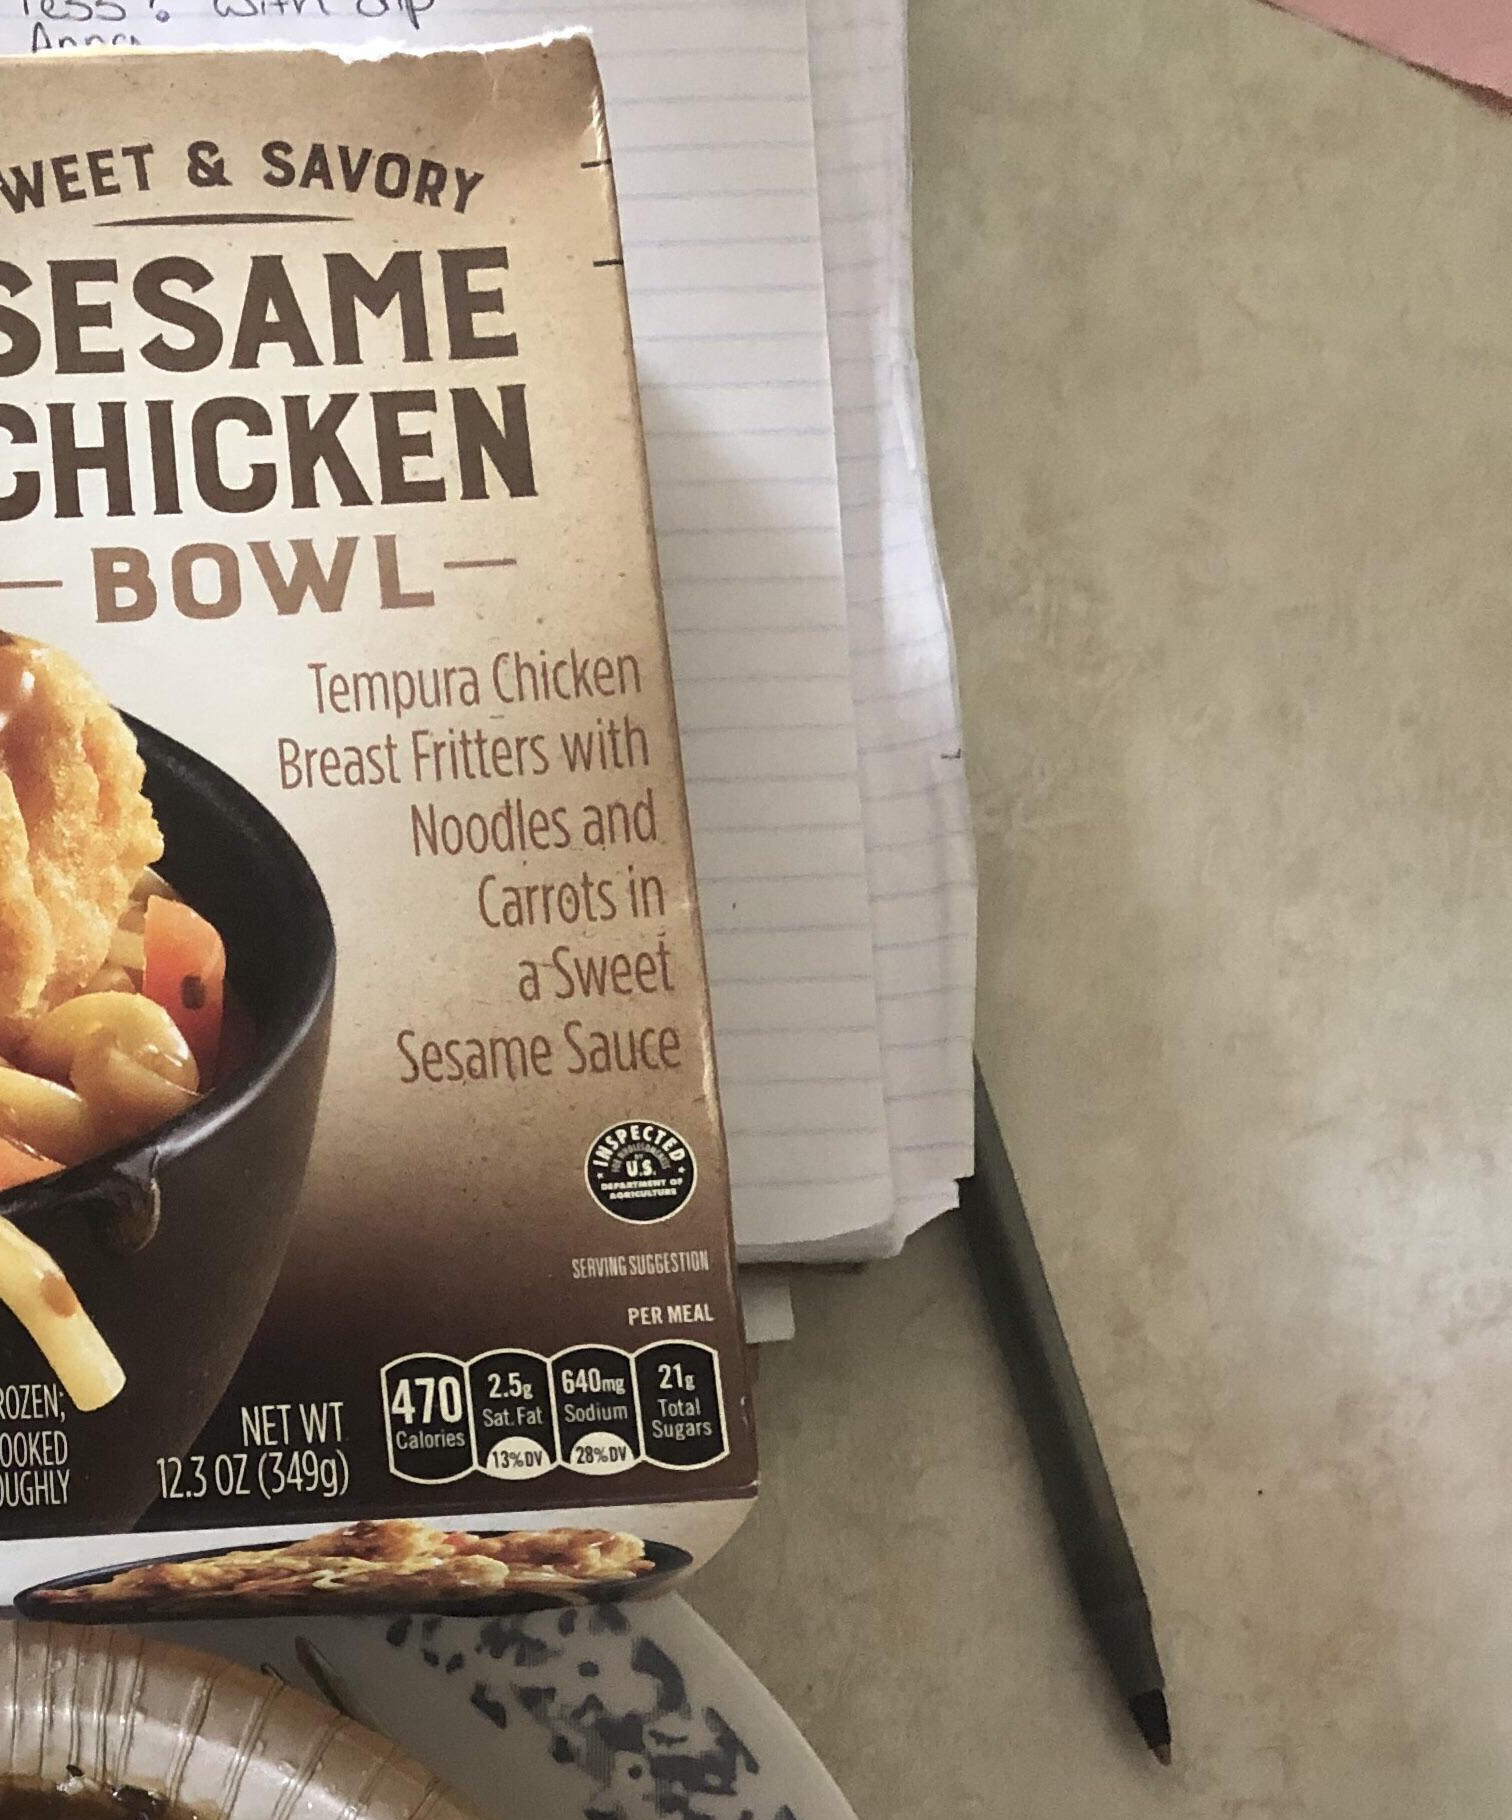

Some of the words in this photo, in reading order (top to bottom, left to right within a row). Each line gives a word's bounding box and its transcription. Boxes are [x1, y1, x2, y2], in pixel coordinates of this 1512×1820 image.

[186, 140, 233, 188] &
[263, 140, 485, 215] SAVORY
[91, 534, 436, 624] BOWL
[307, 660, 481, 719] Tempura
[492, 648, 643, 704] Chicken
[277, 733, 402, 790] Breast
[411, 727, 550, 783] Fritters
[562, 715, 651, 773] with
[410, 797, 572, 857] Noodles
[583, 787, 658, 846] and
[478, 871, 617, 929] Carrots
[627, 865, 666, 920] in
[518, 957, 542, 1001] a
[552, 939, 676, 1001] Sweet
[396, 1028, 553, 1086] Sesame
[563, 1019, 682, 1078] Sauce
[592, 1124, 686, 1168] INSPECTED
[600, 1178, 667, 1191] DEPARTMENT
[669, 1177, 684, 1186] OF
[625, 1159, 657, 1177] U.S.
[609, 1187, 678, 1200] AGRICULTURE
[571, 1255, 627, 1279] SERVING
[628, 1249, 710, 1276] SUGGESTION
[627, 1306, 663, 1326] PER
[667, 1303, 715, 1324] MEAL
[487, 1371, 534, 1399] 2.5g
[561, 1367, 626, 1395] 640mg
[657, 1362, 696, 1391] 21g
[391, 1376, 463, 1425] 470
[564, 1402, 629, 1423] Sodium
[657, 1396, 702, 1418] Total
[240, 1403, 292, 1447] NET
[298, 1401, 345, 1444] WT
[395, 1430, 466, 1450] Calories
[651, 1416, 713, 1441] Sugars
[156, 1455, 208, 1499] 12.3
[214, 1452, 251, 1496] OZ
[258, 1448, 351, 1500] (349g)
